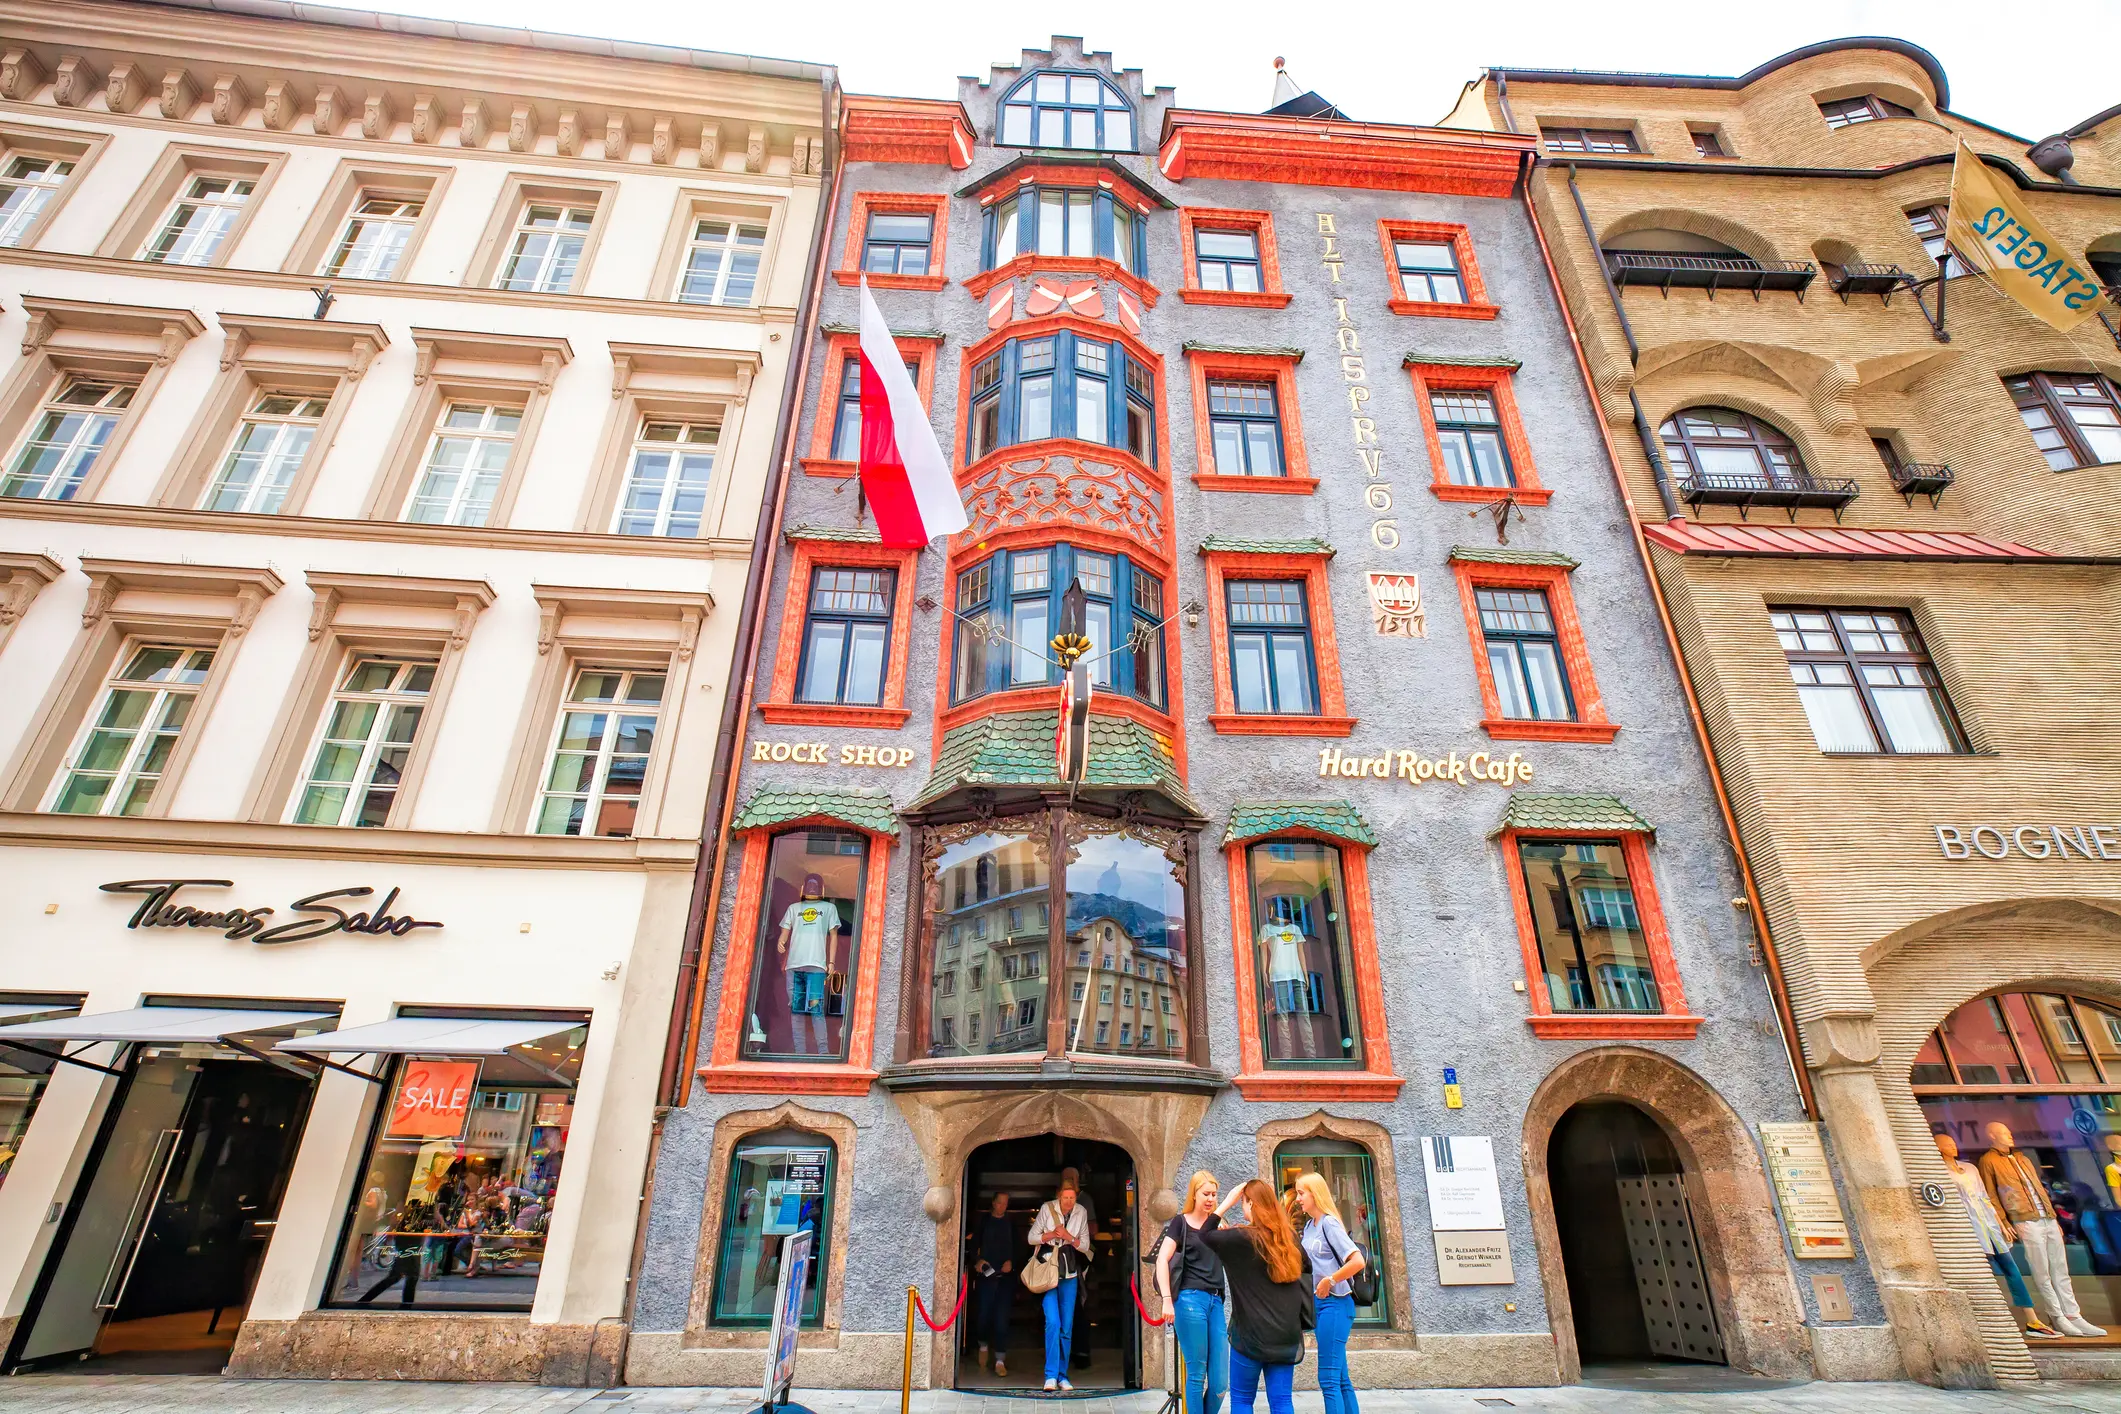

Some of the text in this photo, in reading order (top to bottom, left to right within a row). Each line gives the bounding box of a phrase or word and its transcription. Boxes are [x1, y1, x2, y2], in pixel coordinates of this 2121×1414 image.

[1376, 614, 1424, 637] 1577
[752, 740, 915, 768] ROCK SHOP
[1319, 748, 1534, 786] Hard Rock Cafe
[1934, 824, 2121, 860] BOGNE
[98, 879, 445, 944] Thomas Sabo
[403, 1086, 467, 1109] SALE
